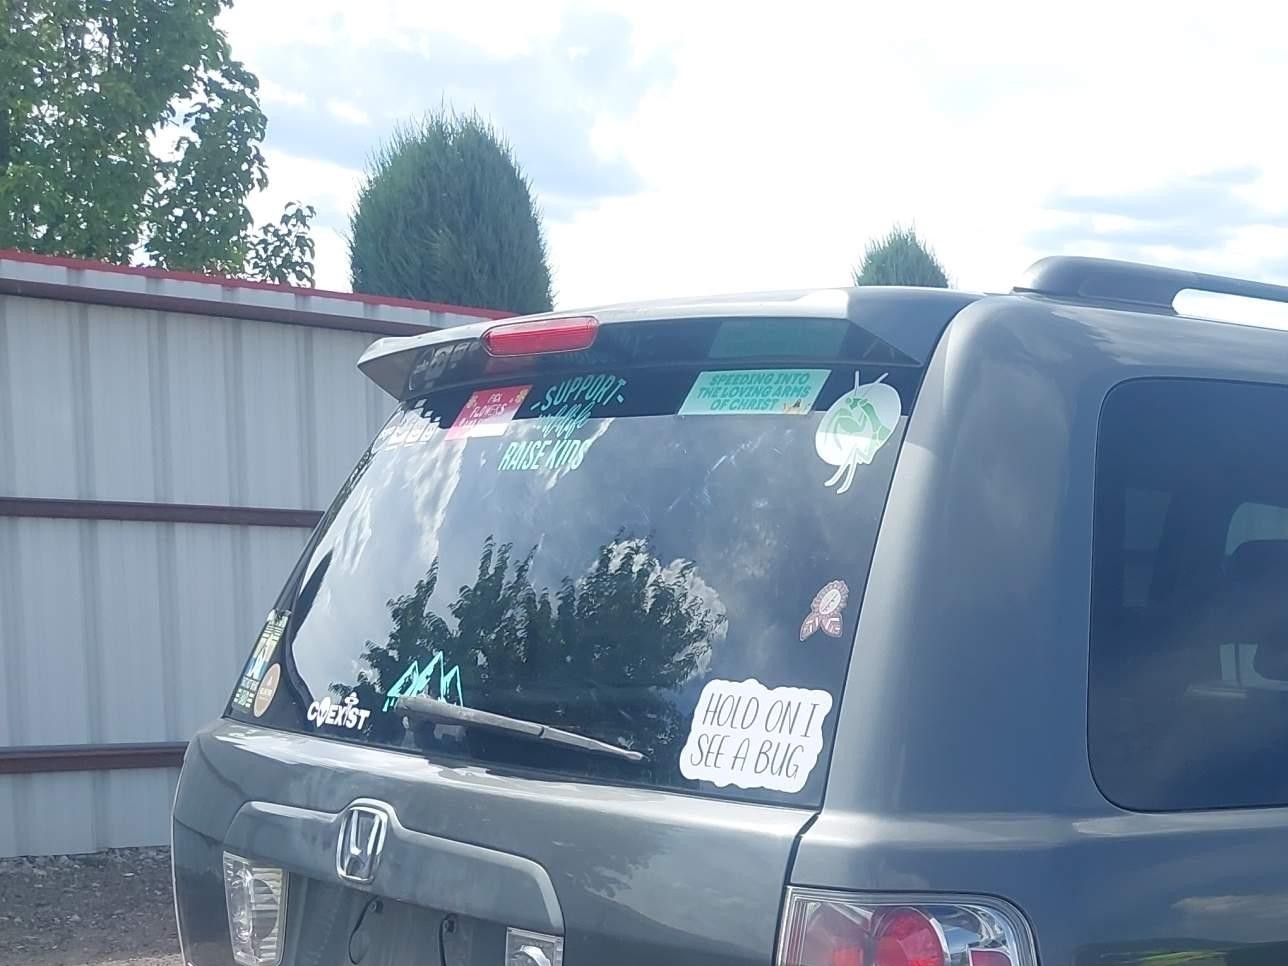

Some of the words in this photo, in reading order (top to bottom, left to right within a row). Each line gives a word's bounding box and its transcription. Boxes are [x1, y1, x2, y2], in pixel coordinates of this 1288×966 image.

[541, 374, 626, 411] SUPPORT
[697, 386, 721, 399] THE
[720, 386, 773, 399] LOVING
[772, 385, 811, 398] ARMS
[709, 373, 772, 386] SPEEDING
[771, 372, 810, 386] INTO
[710, 398, 731, 411] OF
[729, 398, 779, 411] CHRIST
[498, 440, 552, 470] RAISE
[545, 439, 590, 470] KIDS
[702, 693, 760, 730] HOLD
[764, 699, 802, 735] ON
[800, 703, 820, 738] I
[690, 733, 731, 769] SEE
[731, 738, 750, 771] A
[754, 739, 805, 779] BUG
